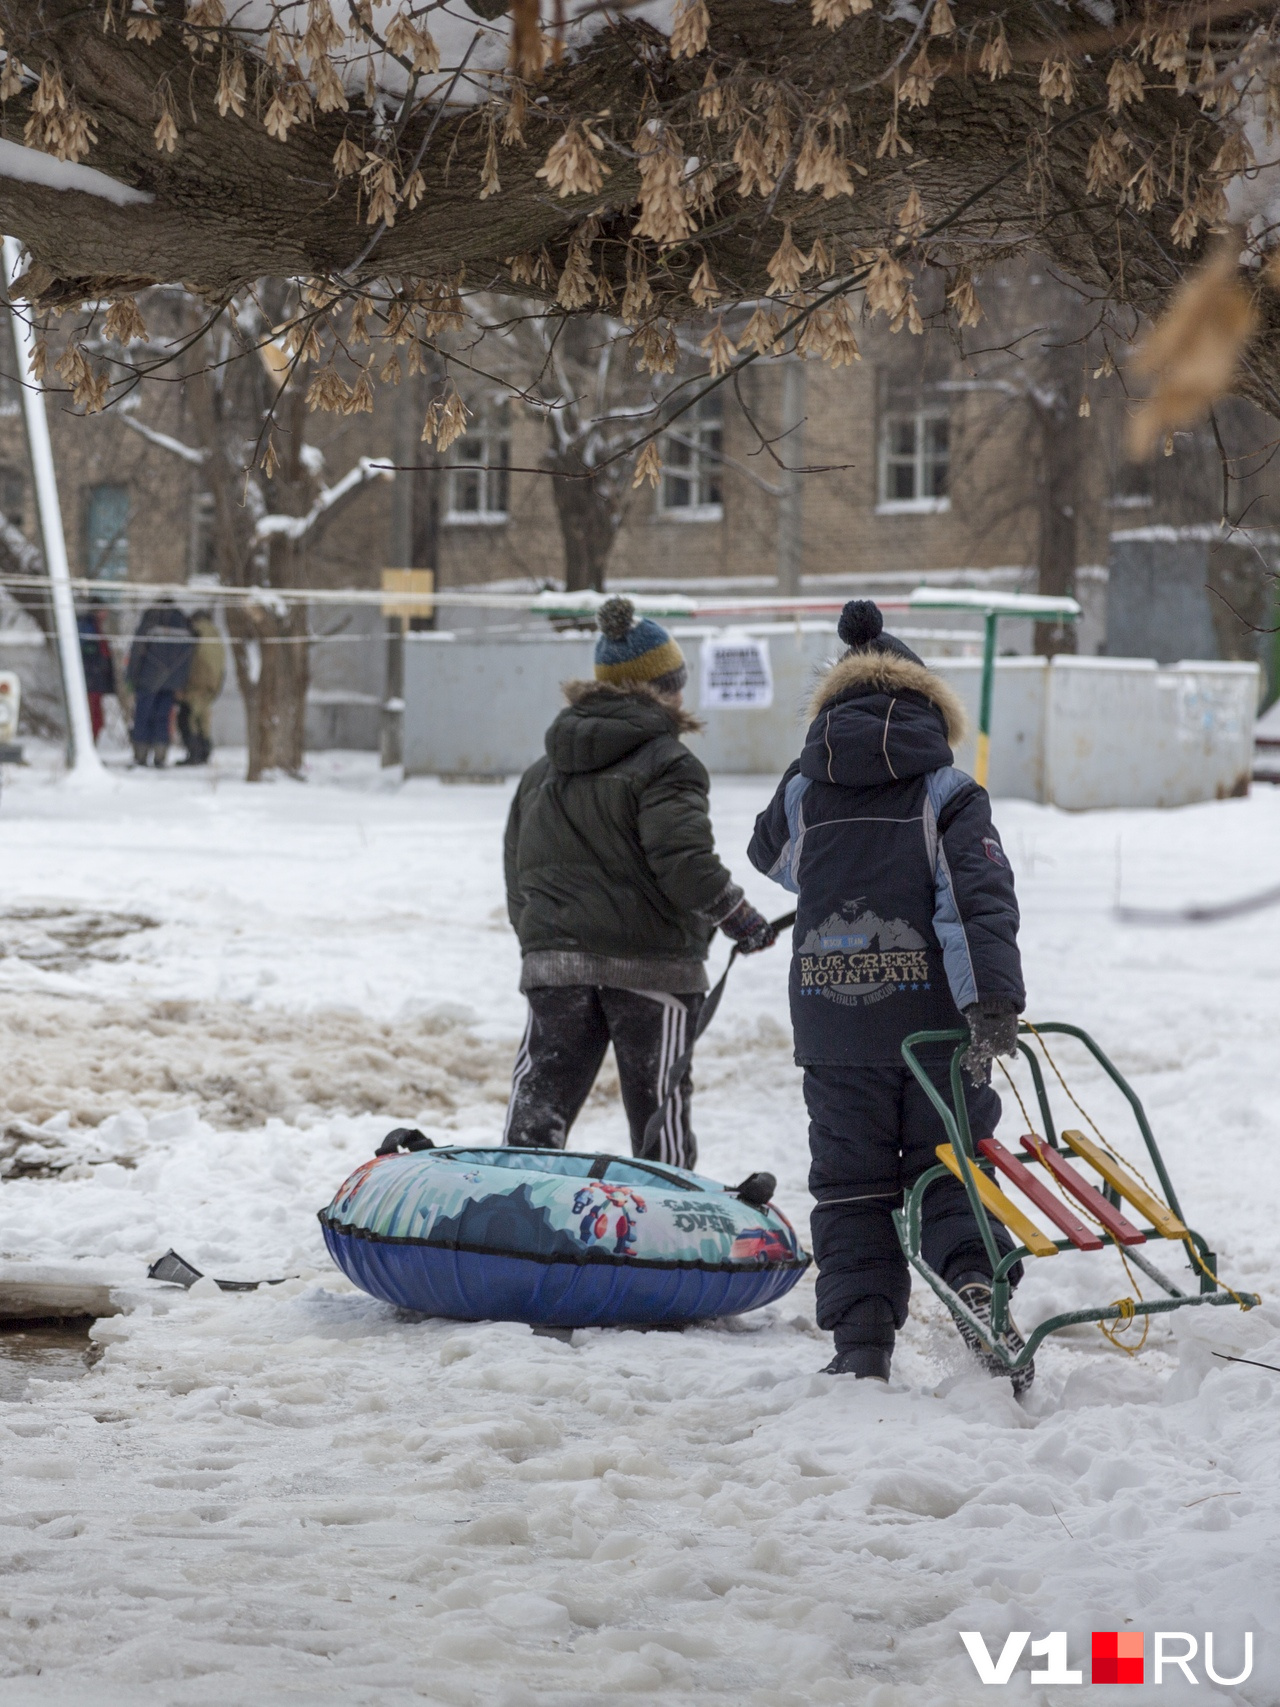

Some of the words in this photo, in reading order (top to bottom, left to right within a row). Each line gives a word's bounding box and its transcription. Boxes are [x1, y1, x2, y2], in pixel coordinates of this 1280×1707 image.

[800, 955, 845, 972] BLUE
[848, 951, 928, 968] CREEK
[801, 966, 928, 986] MOUNTAIN
[662, 1199, 729, 1216] GAME
[674, 1213, 738, 1235] OVER
